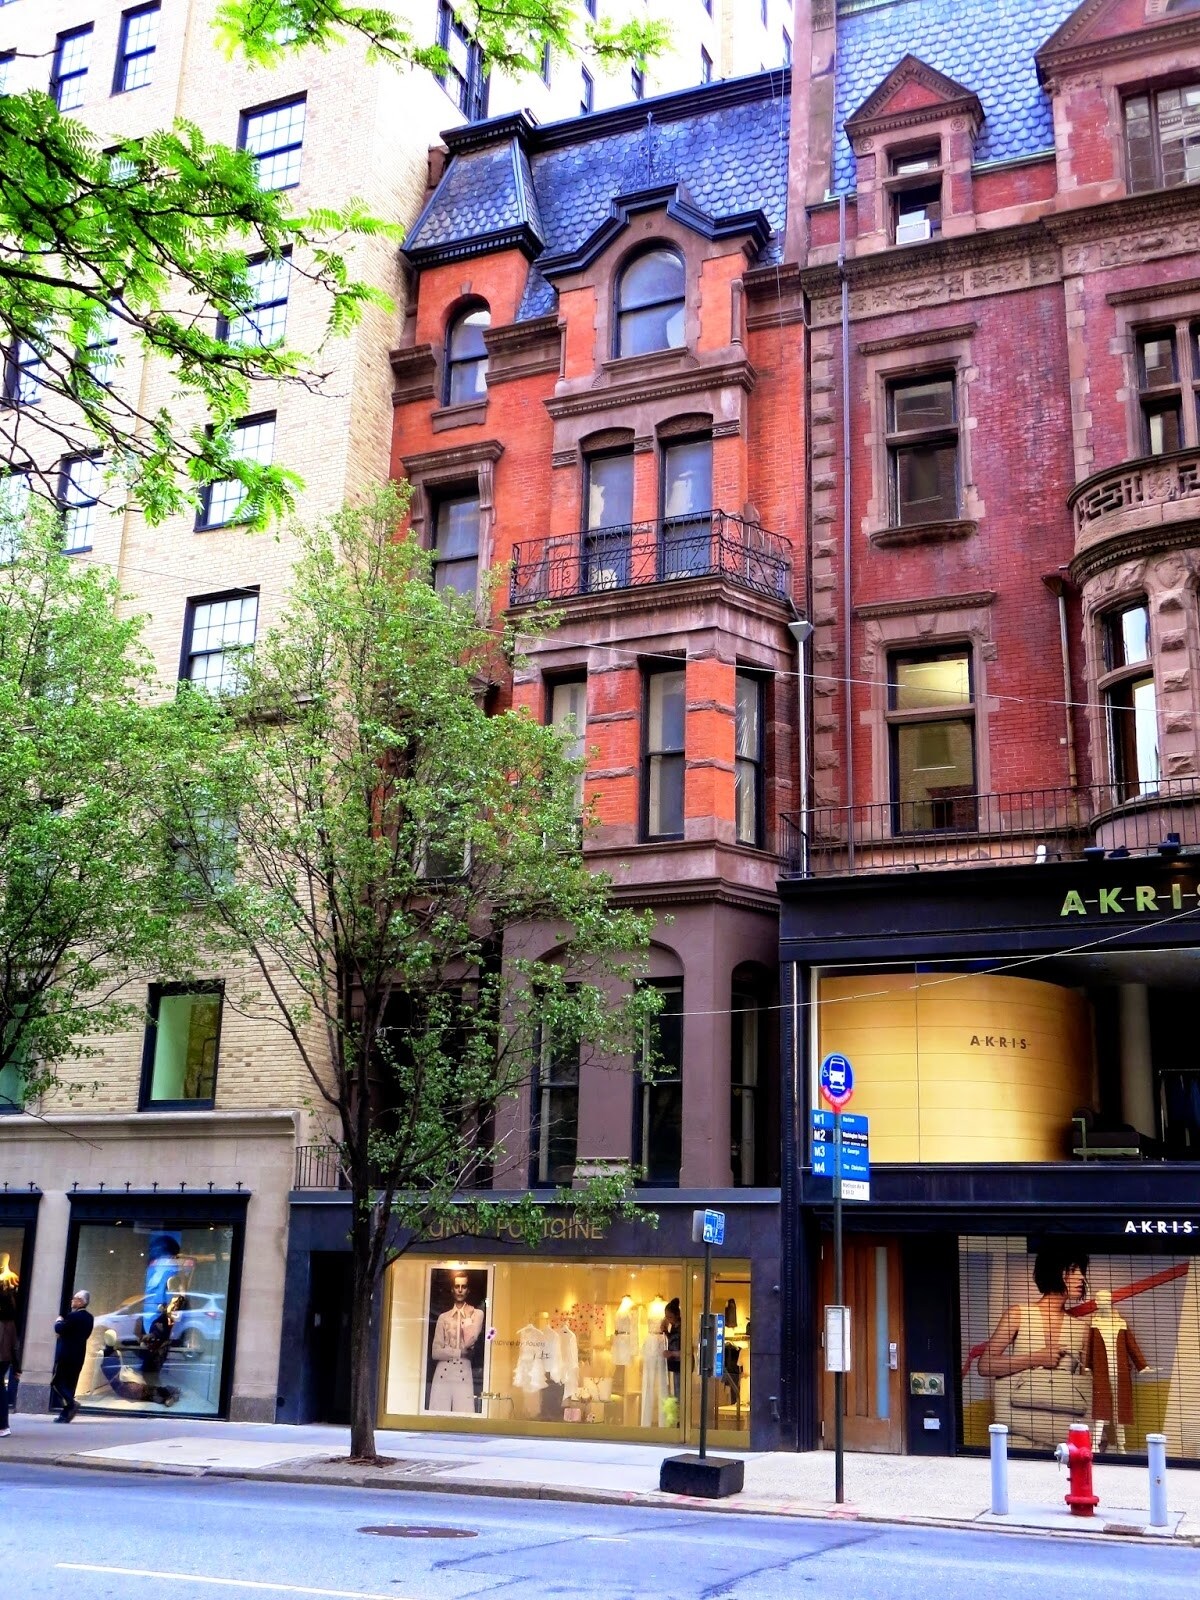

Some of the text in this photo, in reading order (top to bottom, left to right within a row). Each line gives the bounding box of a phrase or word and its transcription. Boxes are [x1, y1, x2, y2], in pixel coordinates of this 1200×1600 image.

[1060, 883, 1200, 916] A-K-R-I-
[814, 1113, 825, 1124] M1
[814, 1129, 826, 1142] M2
[814, 1145, 826, 1157] M3
[814, 1162, 826, 1173] M4
